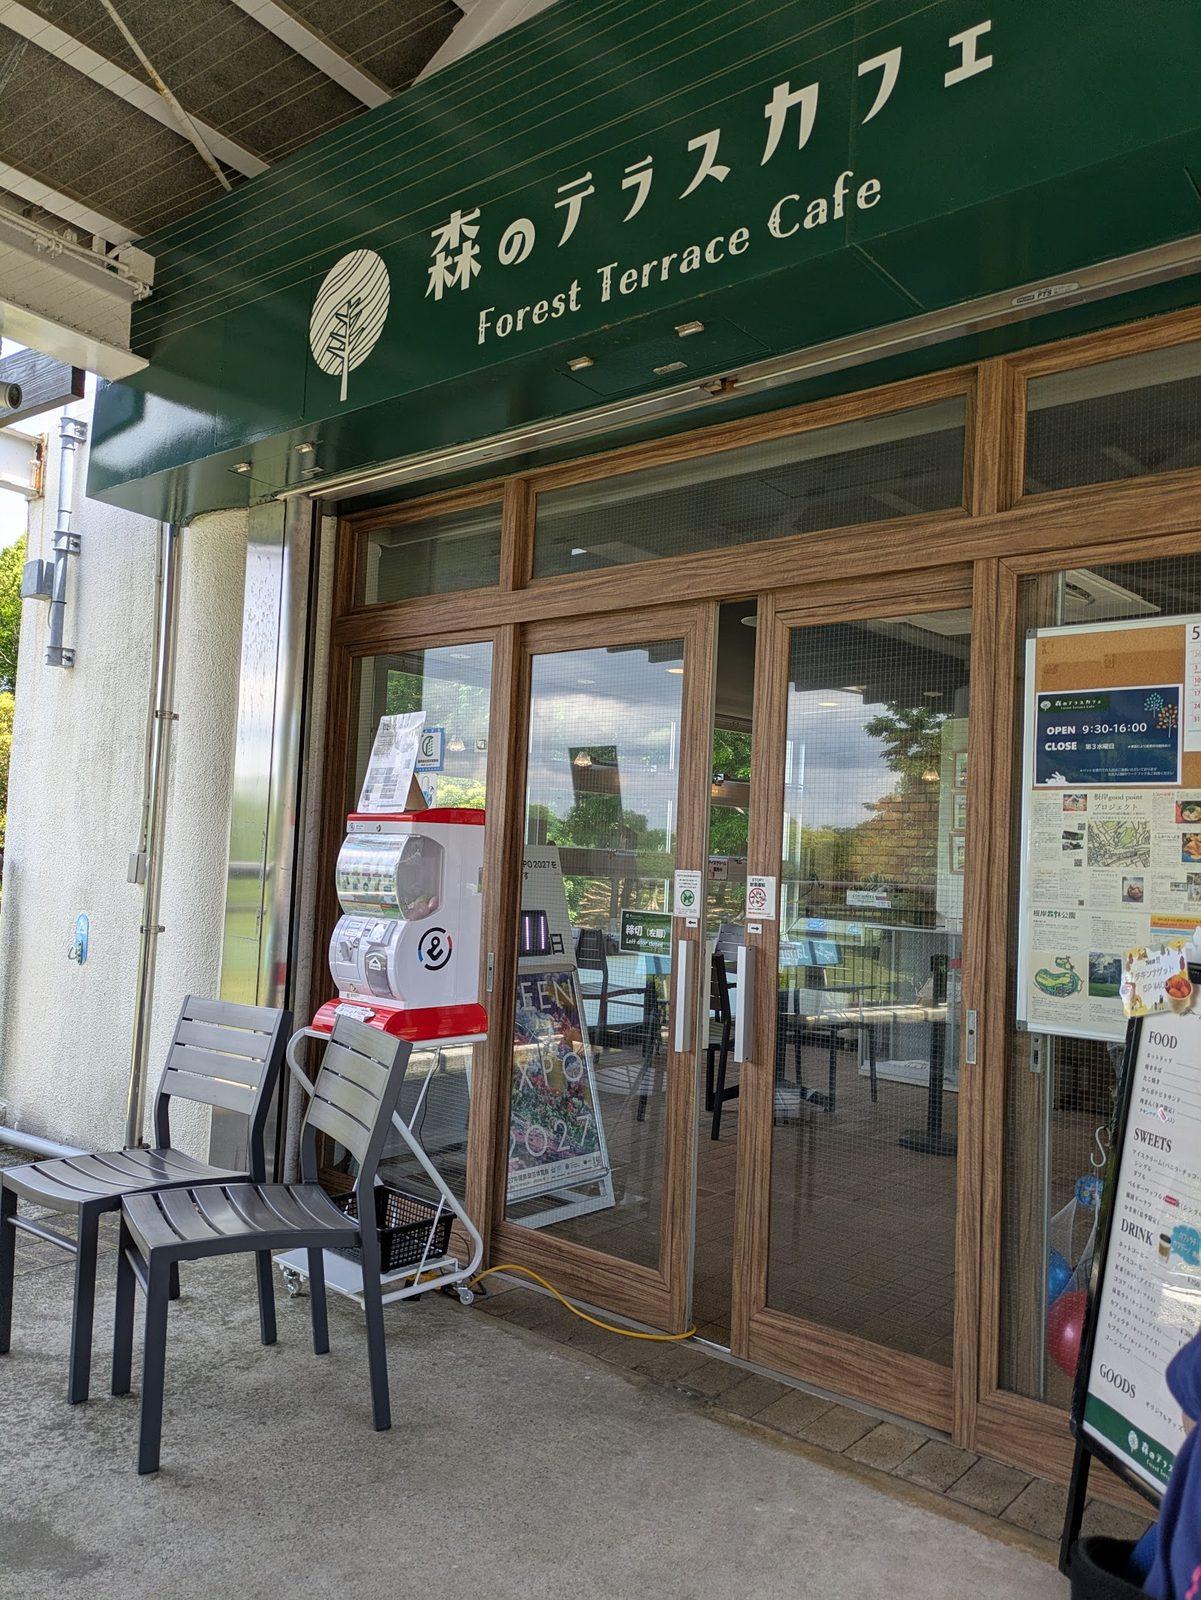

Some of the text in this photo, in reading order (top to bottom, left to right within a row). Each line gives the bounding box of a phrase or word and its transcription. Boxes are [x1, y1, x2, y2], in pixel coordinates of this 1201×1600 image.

[424, 19, 993, 301] 森のテラスカフェ
[477, 171, 882, 345] Forest Terrace Cafe
[1046, 722, 1147, 735] OPEN 9:30-16:00
[1045, 741, 1077, 750] CLOSE
[1094, 803, 1138, 811] プロジェクト
[1148, 1030, 1178, 1049] FOOD
[1133, 1127, 1173, 1153] SWEETS
[1120, 1218, 1154, 1246] DRINK
[1099, 1363, 1137, 1399] GOODS
